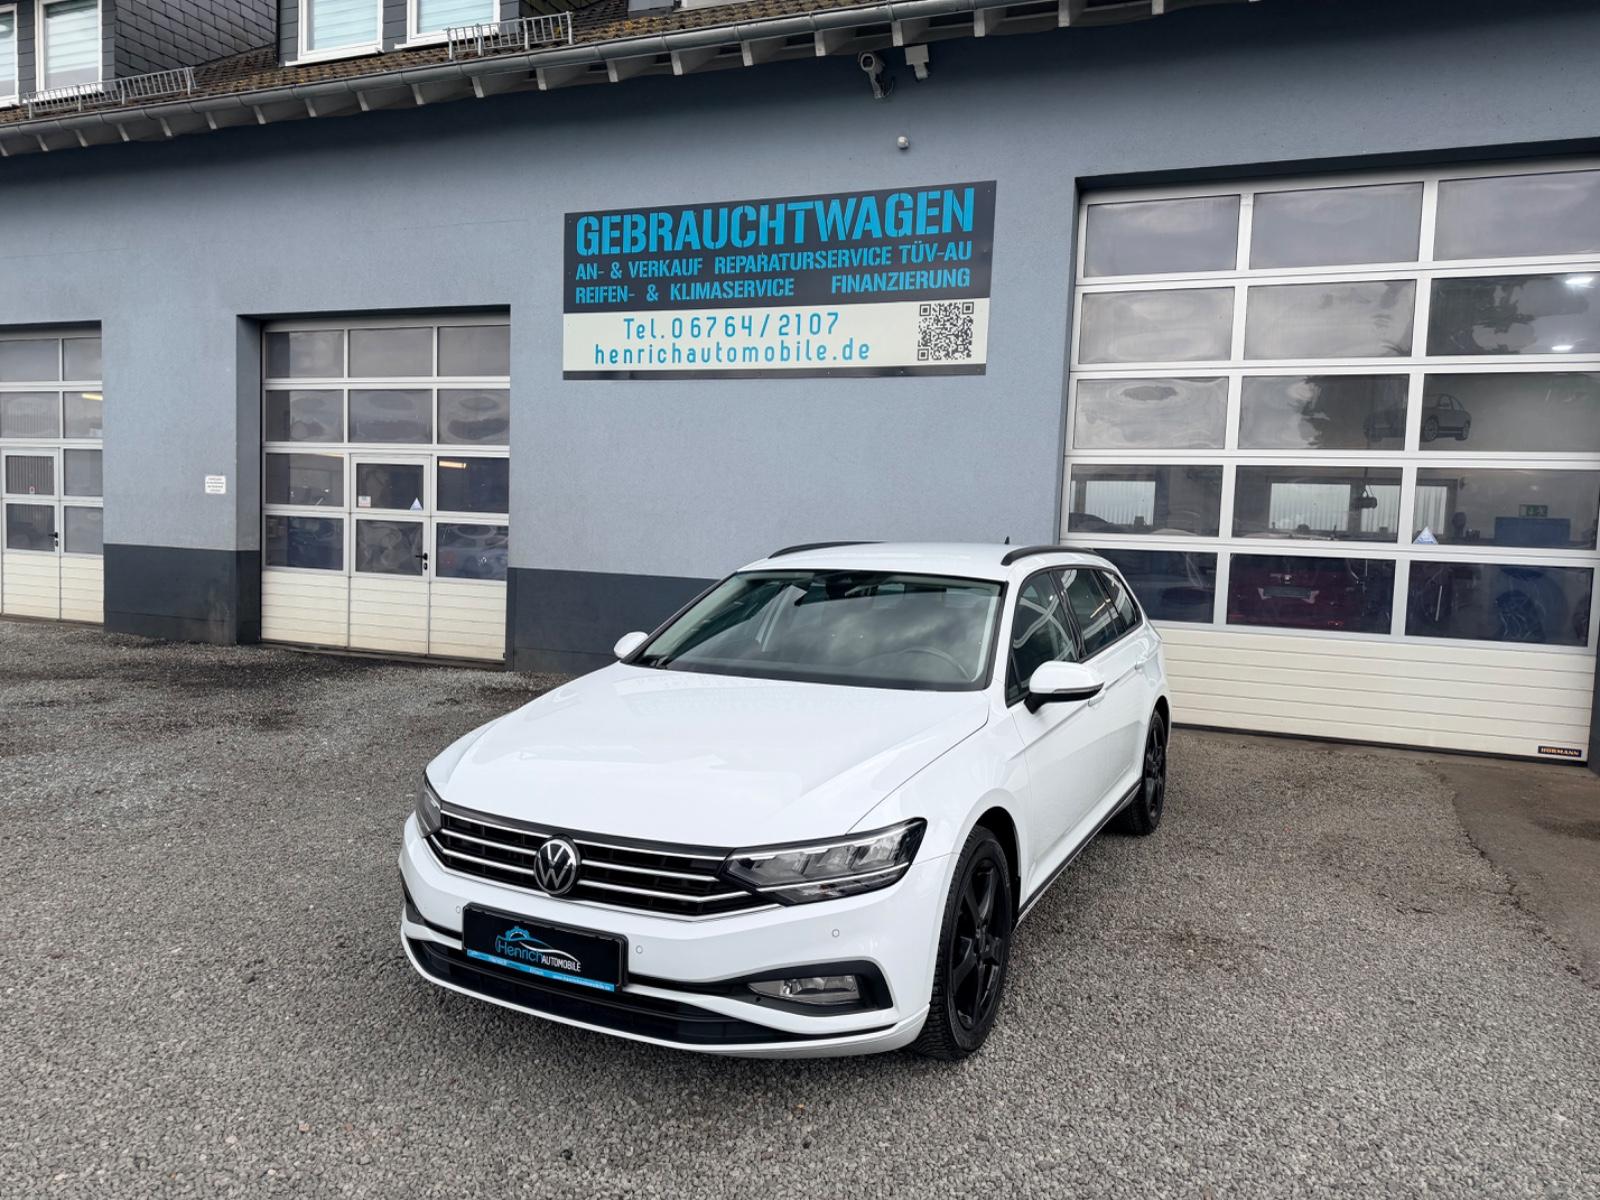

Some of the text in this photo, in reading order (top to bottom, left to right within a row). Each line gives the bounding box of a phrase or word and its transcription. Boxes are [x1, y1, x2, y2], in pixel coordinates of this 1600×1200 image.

[576, 187, 975, 256] GEBRAUCHTWAGEN
[575, 240, 973, 281] AN- & VERKAUF REPARATURSERVICE TÜV-AU
[575, 267, 971, 304] REIFEN- & KLIMASERVICE FINANZIERUNG
[594, 338, 871, 364] henrichautomobile.de
